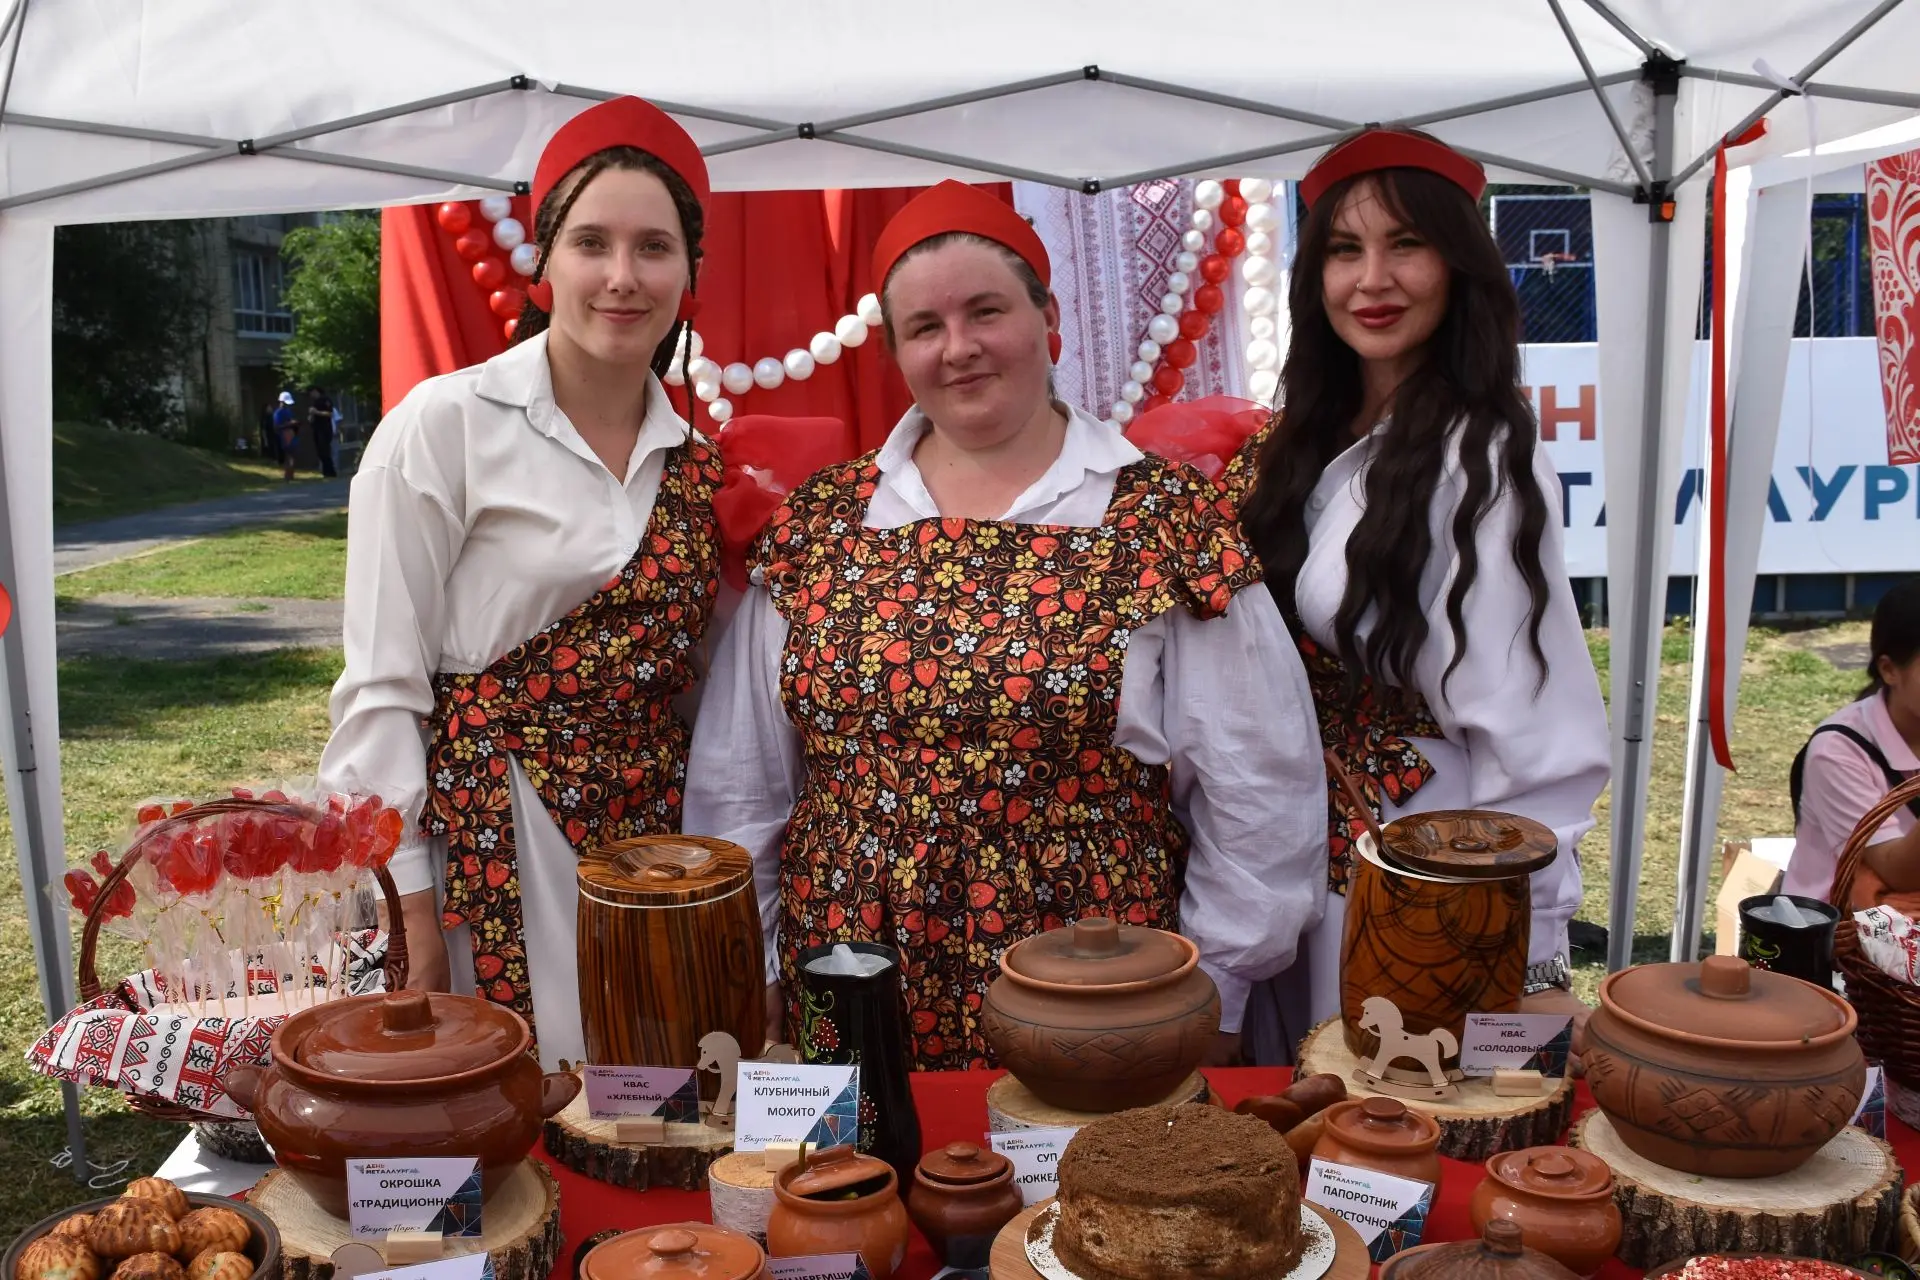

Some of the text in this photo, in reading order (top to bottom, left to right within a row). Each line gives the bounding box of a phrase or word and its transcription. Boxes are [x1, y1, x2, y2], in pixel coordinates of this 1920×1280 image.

[1521, 384, 1597, 442] Н
[1500, 1030, 1526, 1038] КВАС
[754, 1086, 830, 1097] КЛУБНИЧНЫЙ
[768, 1107, 816, 1117] МОХИТО
[1037, 1153, 1058, 1162] СУП
[380, 1178, 441, 1188] ОКРОШКА
[1323, 1185, 1398, 1210] ПАПОРОТНИК
